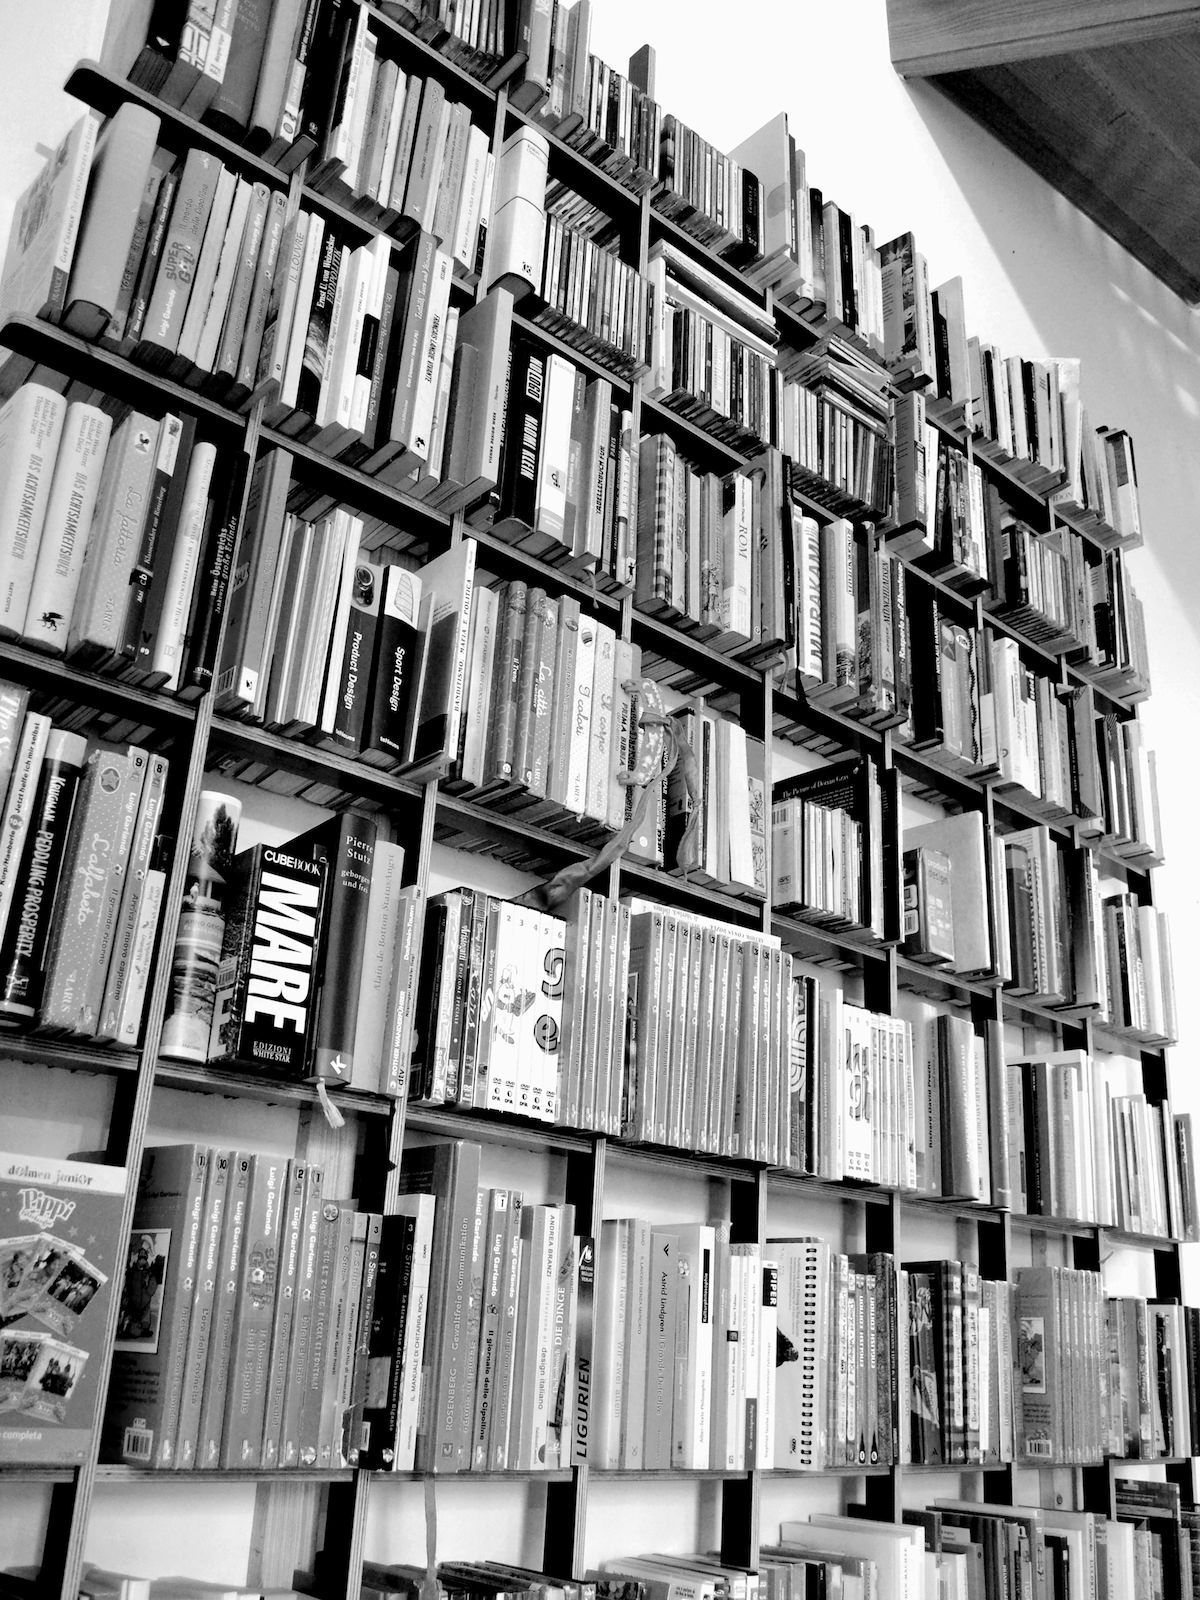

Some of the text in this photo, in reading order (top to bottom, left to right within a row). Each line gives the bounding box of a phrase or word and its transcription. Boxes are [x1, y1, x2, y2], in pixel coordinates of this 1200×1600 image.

[252, 212, 263, 229] Luigi
[271, 221, 280, 238] Luigi
[164, 240, 184, 281] SUPER
[291, 230, 305, 271] LOUVRE
[317, 233, 337, 308] Ernst U. von Weizsäcker
[326, 247, 342, 304] ERDPOLITIK
[157, 288, 177, 337] Luigi Garlando
[424, 340, 437, 384] LANGUE VIVANTE
[525, 356, 542, 404] NO LOGO
[519, 413, 538, 481] NAOMI KLEIN
[11, 455, 43, 561] DAS ACHTSAMKEITSBUCH
[55, 473, 87, 578] DAS ACHTSAMKEITSBUCH
[112, 486, 143, 567] La fattoria
[210, 514, 238, 579] Österreichs große Erfinder
[738, 523, 748, 560] ROM
[805, 536, 822, 659] MURAKAMI
[882, 559, 891, 625] MÜNCHHAUSEN
[896, 561, 907, 660] Kasperle auf Abenteuer
[343, 632, 363, 711] Product Design
[453, 579, 472, 712] BANDITISMO, MAFIA POLITICA
[389, 646, 406, 712] Sport Design
[536, 661, 552, 720] La città
[575, 700, 589, 737] colori
[593, 717, 609, 755] corpo
[618, 702, 629, 767] PRIMA BIBBIA
[14, 721, 41, 814] Jetzt helfe ich mir selbst
[118, 791, 137, 856] Luigi Garlando
[144, 798, 156, 820] Luigi
[15, 775, 67, 958] KRUGMAN PEDDLING PROSPERITY
[138, 821, 152, 862] Garlando
[264, 849, 323, 876] CUBEBOOK
[346, 835, 375, 854] Pierre
[347, 848, 372, 864] Stutz
[97, 896, 116, 967] grande ritorno
[112, 894, 138, 1002] Arriva nuovo capitano
[244, 871, 321, 1035] MARE
[373, 912, 389, 992] Alain de Botton
[403, 904, 415, 961] Dachstein-Tauern
[456, 963, 464, 994] EDIZIONE
[253, 1040, 293, 1055] EDIZIONI
[253, 1048, 292, 1065] WHITE STAR
[391, 990, 406, 1077] ROTHER WANDERFÜHRER
[397, 1068, 405, 1086] dtv
[8, 1164, 93, 1186] dolmen junior
[218, 1158, 227, 1170] 10
[241, 1161, 248, 1172] 9
[297, 1169, 304, 1180] 2
[263, 1166, 277, 1237] Luigi Garlando
[186, 1196, 201, 1269] Luigi Garlando
[205, 1199, 221, 1271] Luigi Garlando
[229, 1200, 243, 1272] Luigi Garlando
[287, 1206, 301, 1277] Luigi Garlando
[305, 1210, 319, 1279] Luigi Garlando
[368, 1251, 377, 1261] G.
[471, 1217, 481, 1263] Garlando
[263, 1247, 276, 1306] SUPER
[366, 1261, 376, 1289] Stilton
[401, 1253, 412, 1287] Stilton
[490, 1233, 502, 1298] Luigi Garlando
[508, 1235, 519, 1299] Luigi Garlando
[545, 1248, 554, 1277] BRANZI
[769, 1272, 778, 1306] PIPER
[411, 1293, 425, 1392] MANUALE CHITARRA ROCK
[444, 1217, 469, 1432] ROSENBERG Gewaltfreie Kommunikation
[553, 1286, 566, 1346] DIE DINGE
[659, 1297, 667, 1333] Lindgren
[190, 1334, 206, 1405] della rivincita
[483, 1337, 493, 1376] giornale
[537, 1347, 548, 1410] design italiano
[481, 1376, 490, 1399] delle
[576, 1356, 591, 1459] LIGURIEN
[479, 1401, 488, 1441] Cipolline
